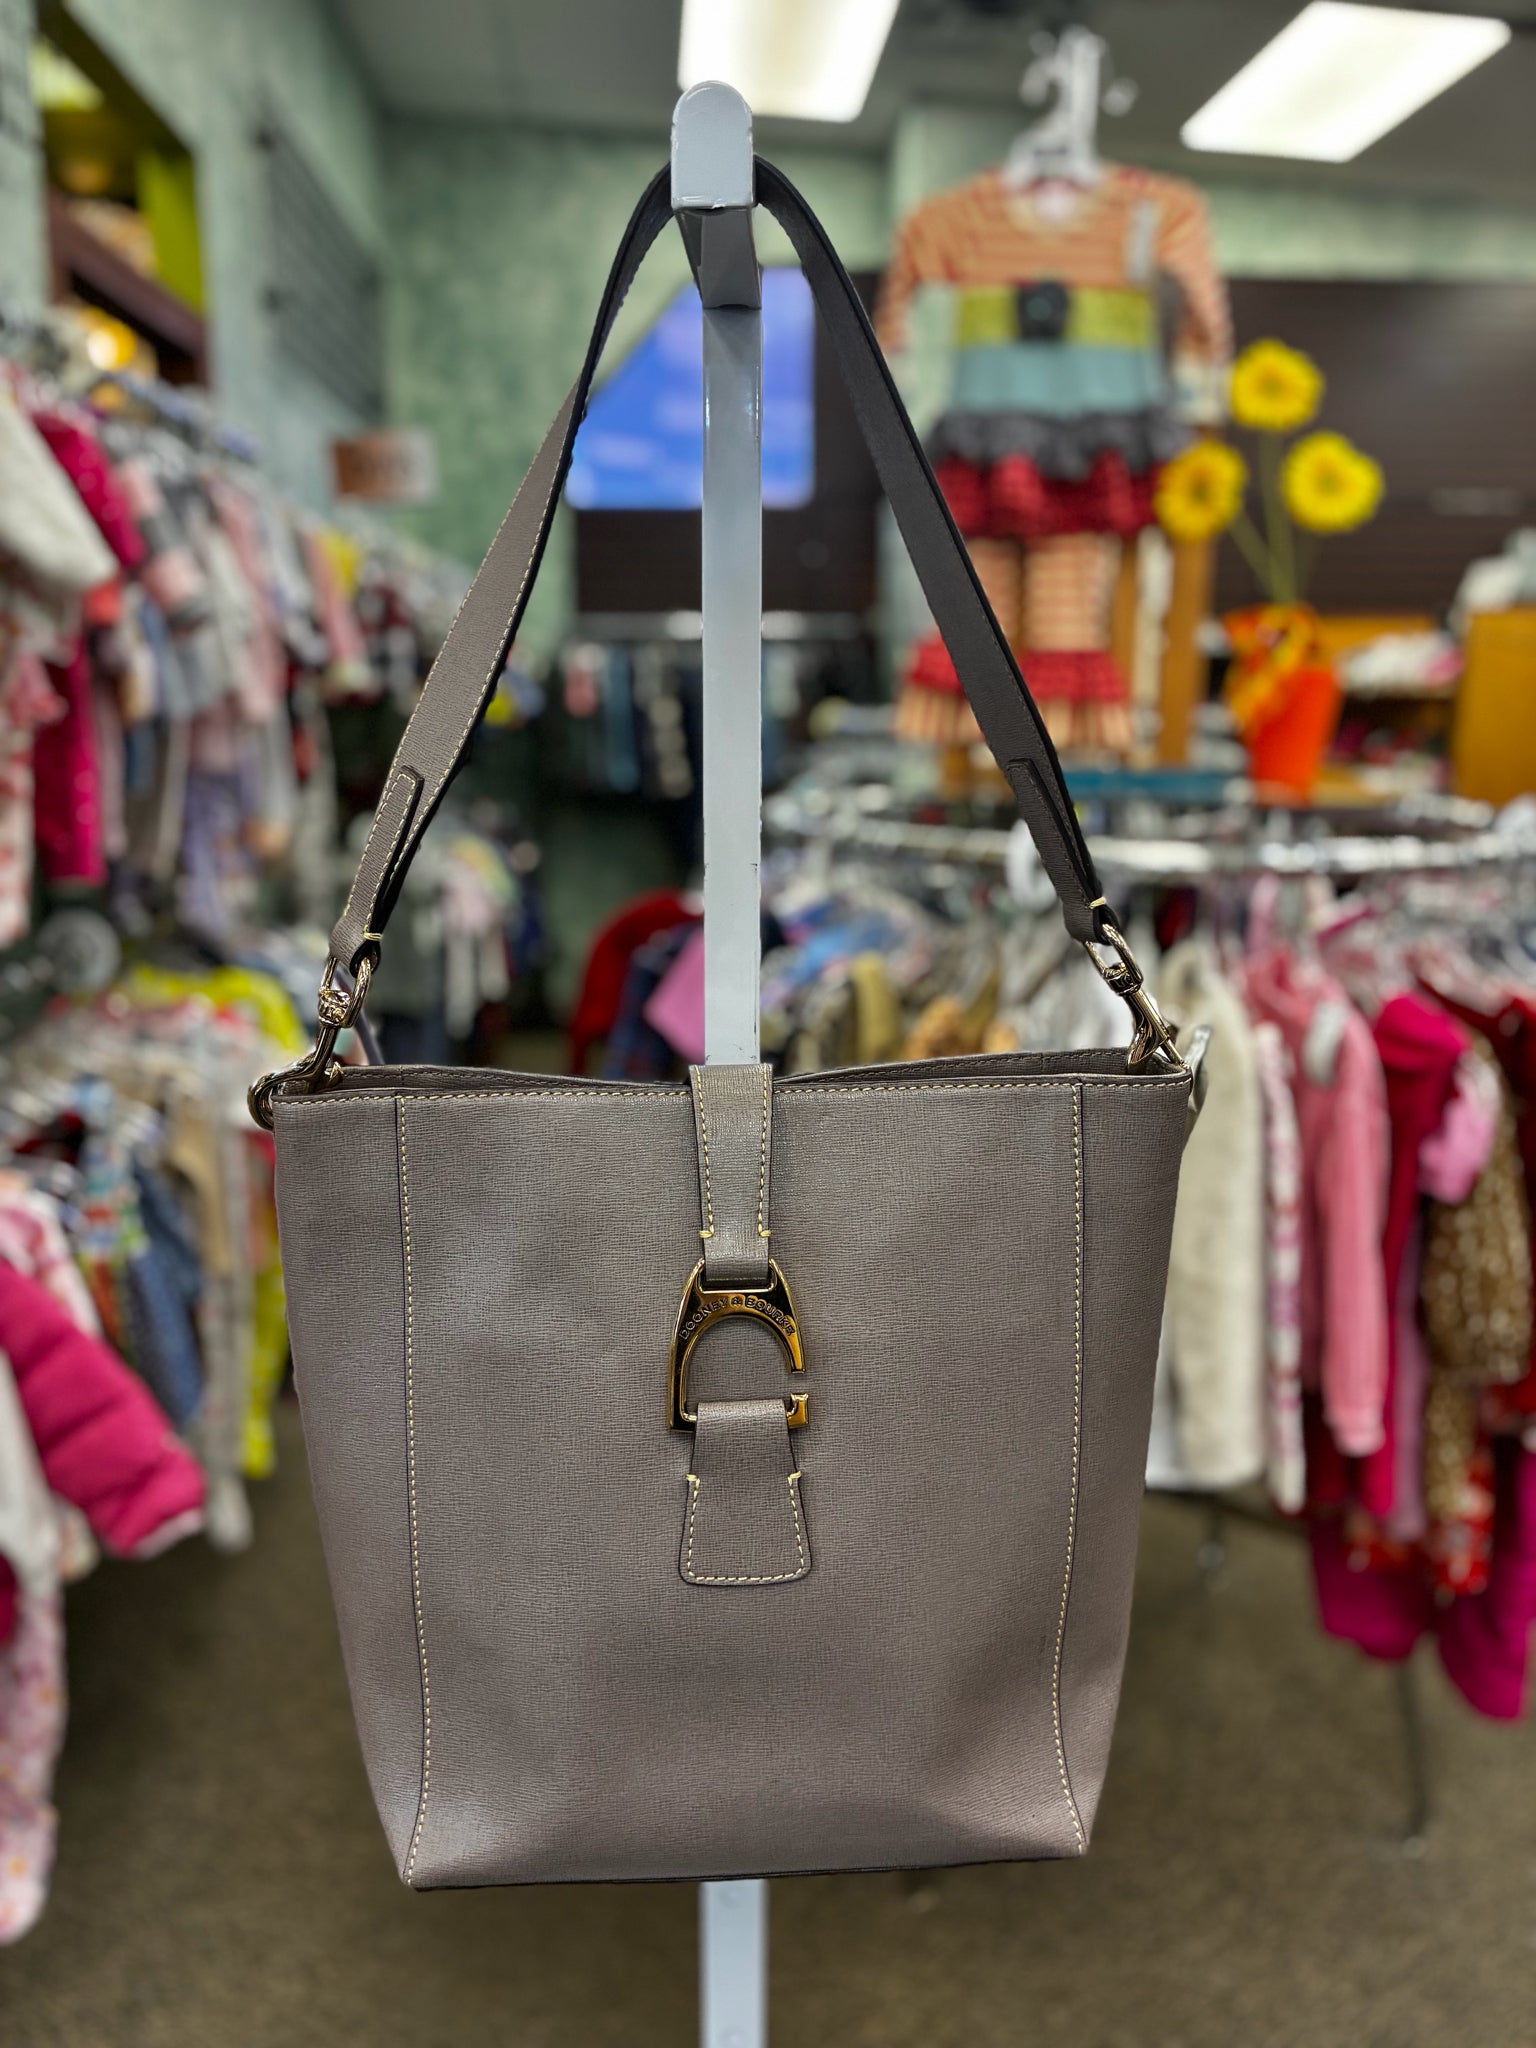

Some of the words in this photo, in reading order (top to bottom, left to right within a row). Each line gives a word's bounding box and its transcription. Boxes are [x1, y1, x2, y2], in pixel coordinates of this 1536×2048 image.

[679, 1298, 728, 1340] DOONEY
[731, 1297, 742, 1307] &
[744, 1297, 796, 1337] BOURKE
